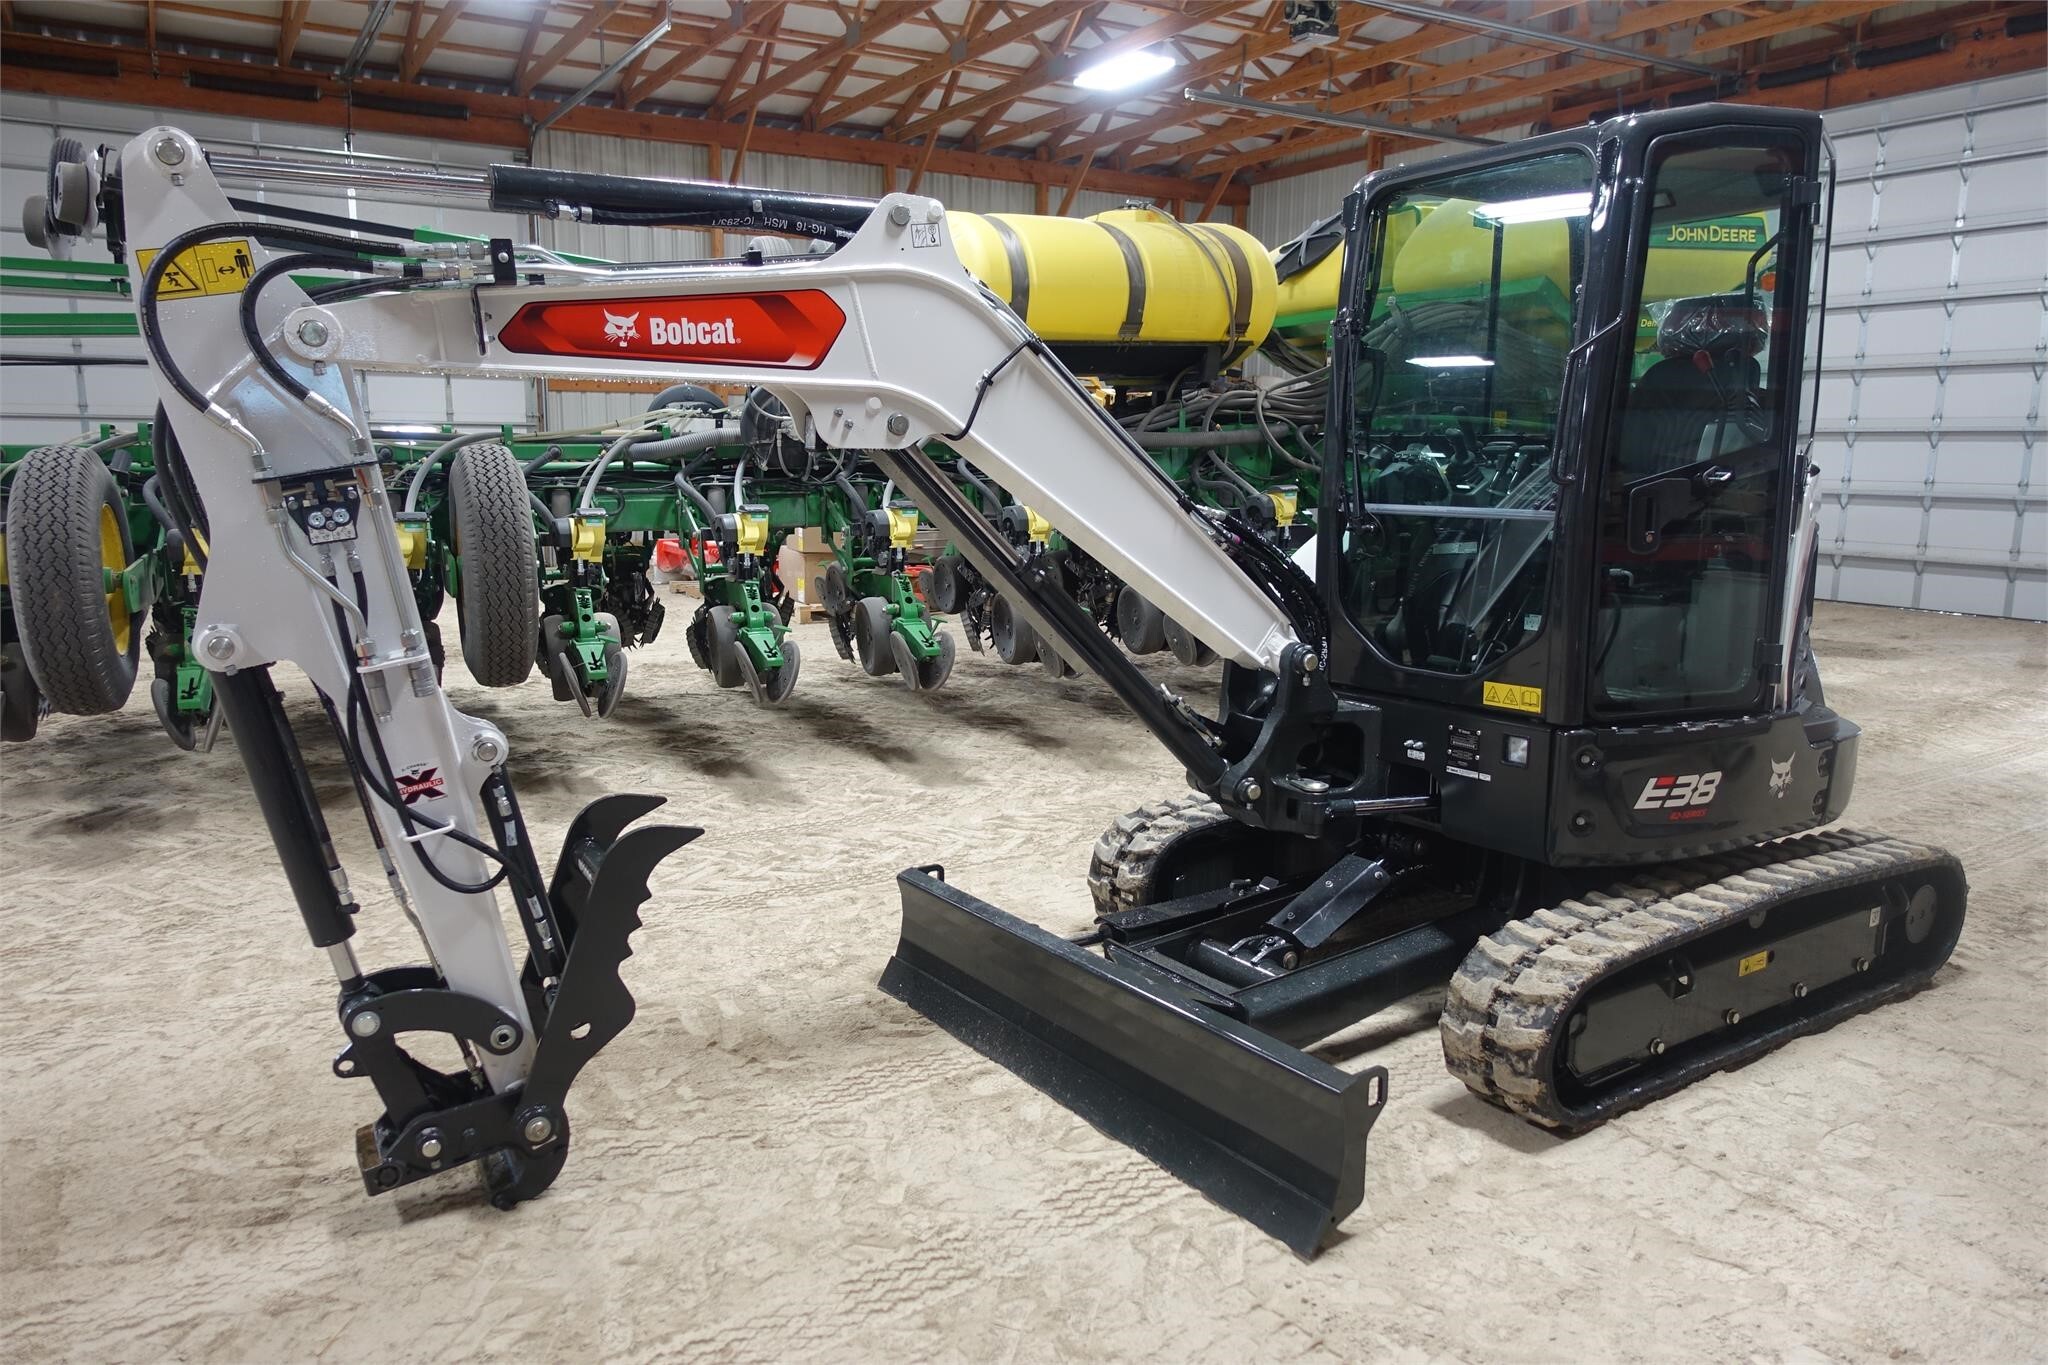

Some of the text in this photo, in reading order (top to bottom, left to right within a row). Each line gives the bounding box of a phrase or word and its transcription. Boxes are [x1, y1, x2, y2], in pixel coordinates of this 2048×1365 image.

[763, 216, 788, 230] MSH
[795, 221, 827, 236] HG-16
[1667, 224, 1757, 243] JOHN DEERE
[649, 317, 737, 345] Bobcat
[1633, 770, 1723, 809] E38
